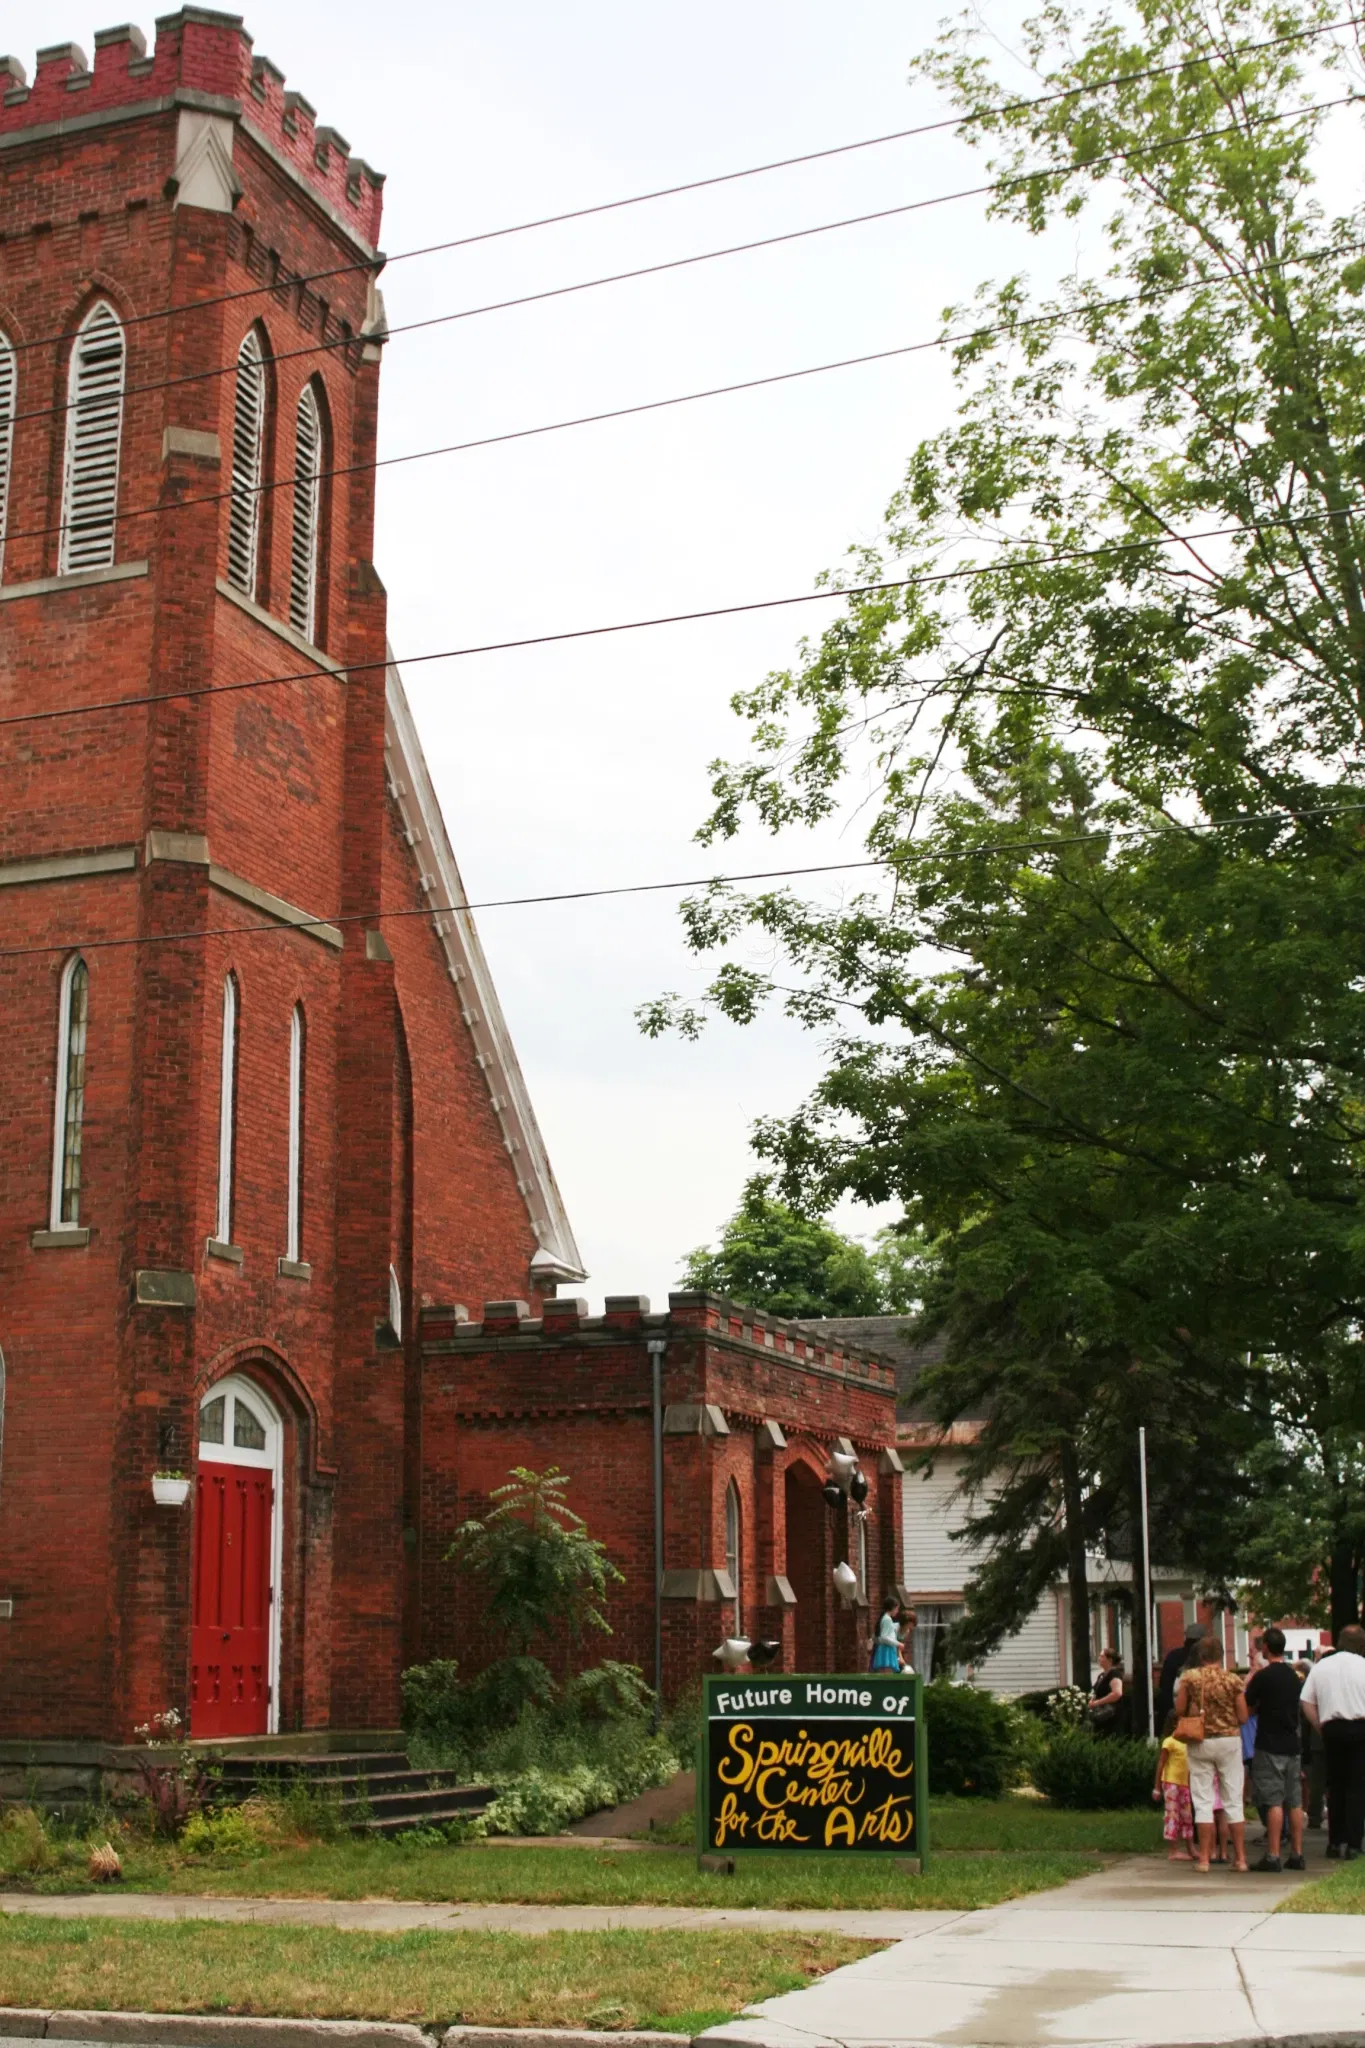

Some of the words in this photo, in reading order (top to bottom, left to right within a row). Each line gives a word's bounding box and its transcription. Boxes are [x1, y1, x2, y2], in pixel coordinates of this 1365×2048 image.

[717, 1688, 792, 1714] Future
[806, 1684, 873, 1707] Home
[882, 1696, 909, 1715] of
[717, 1723, 914, 1793] Springville
[756, 1766, 866, 1809] Center
[714, 1792, 750, 1847] for
[751, 1809, 810, 1841] the
[824, 1793, 914, 1846] Arts
